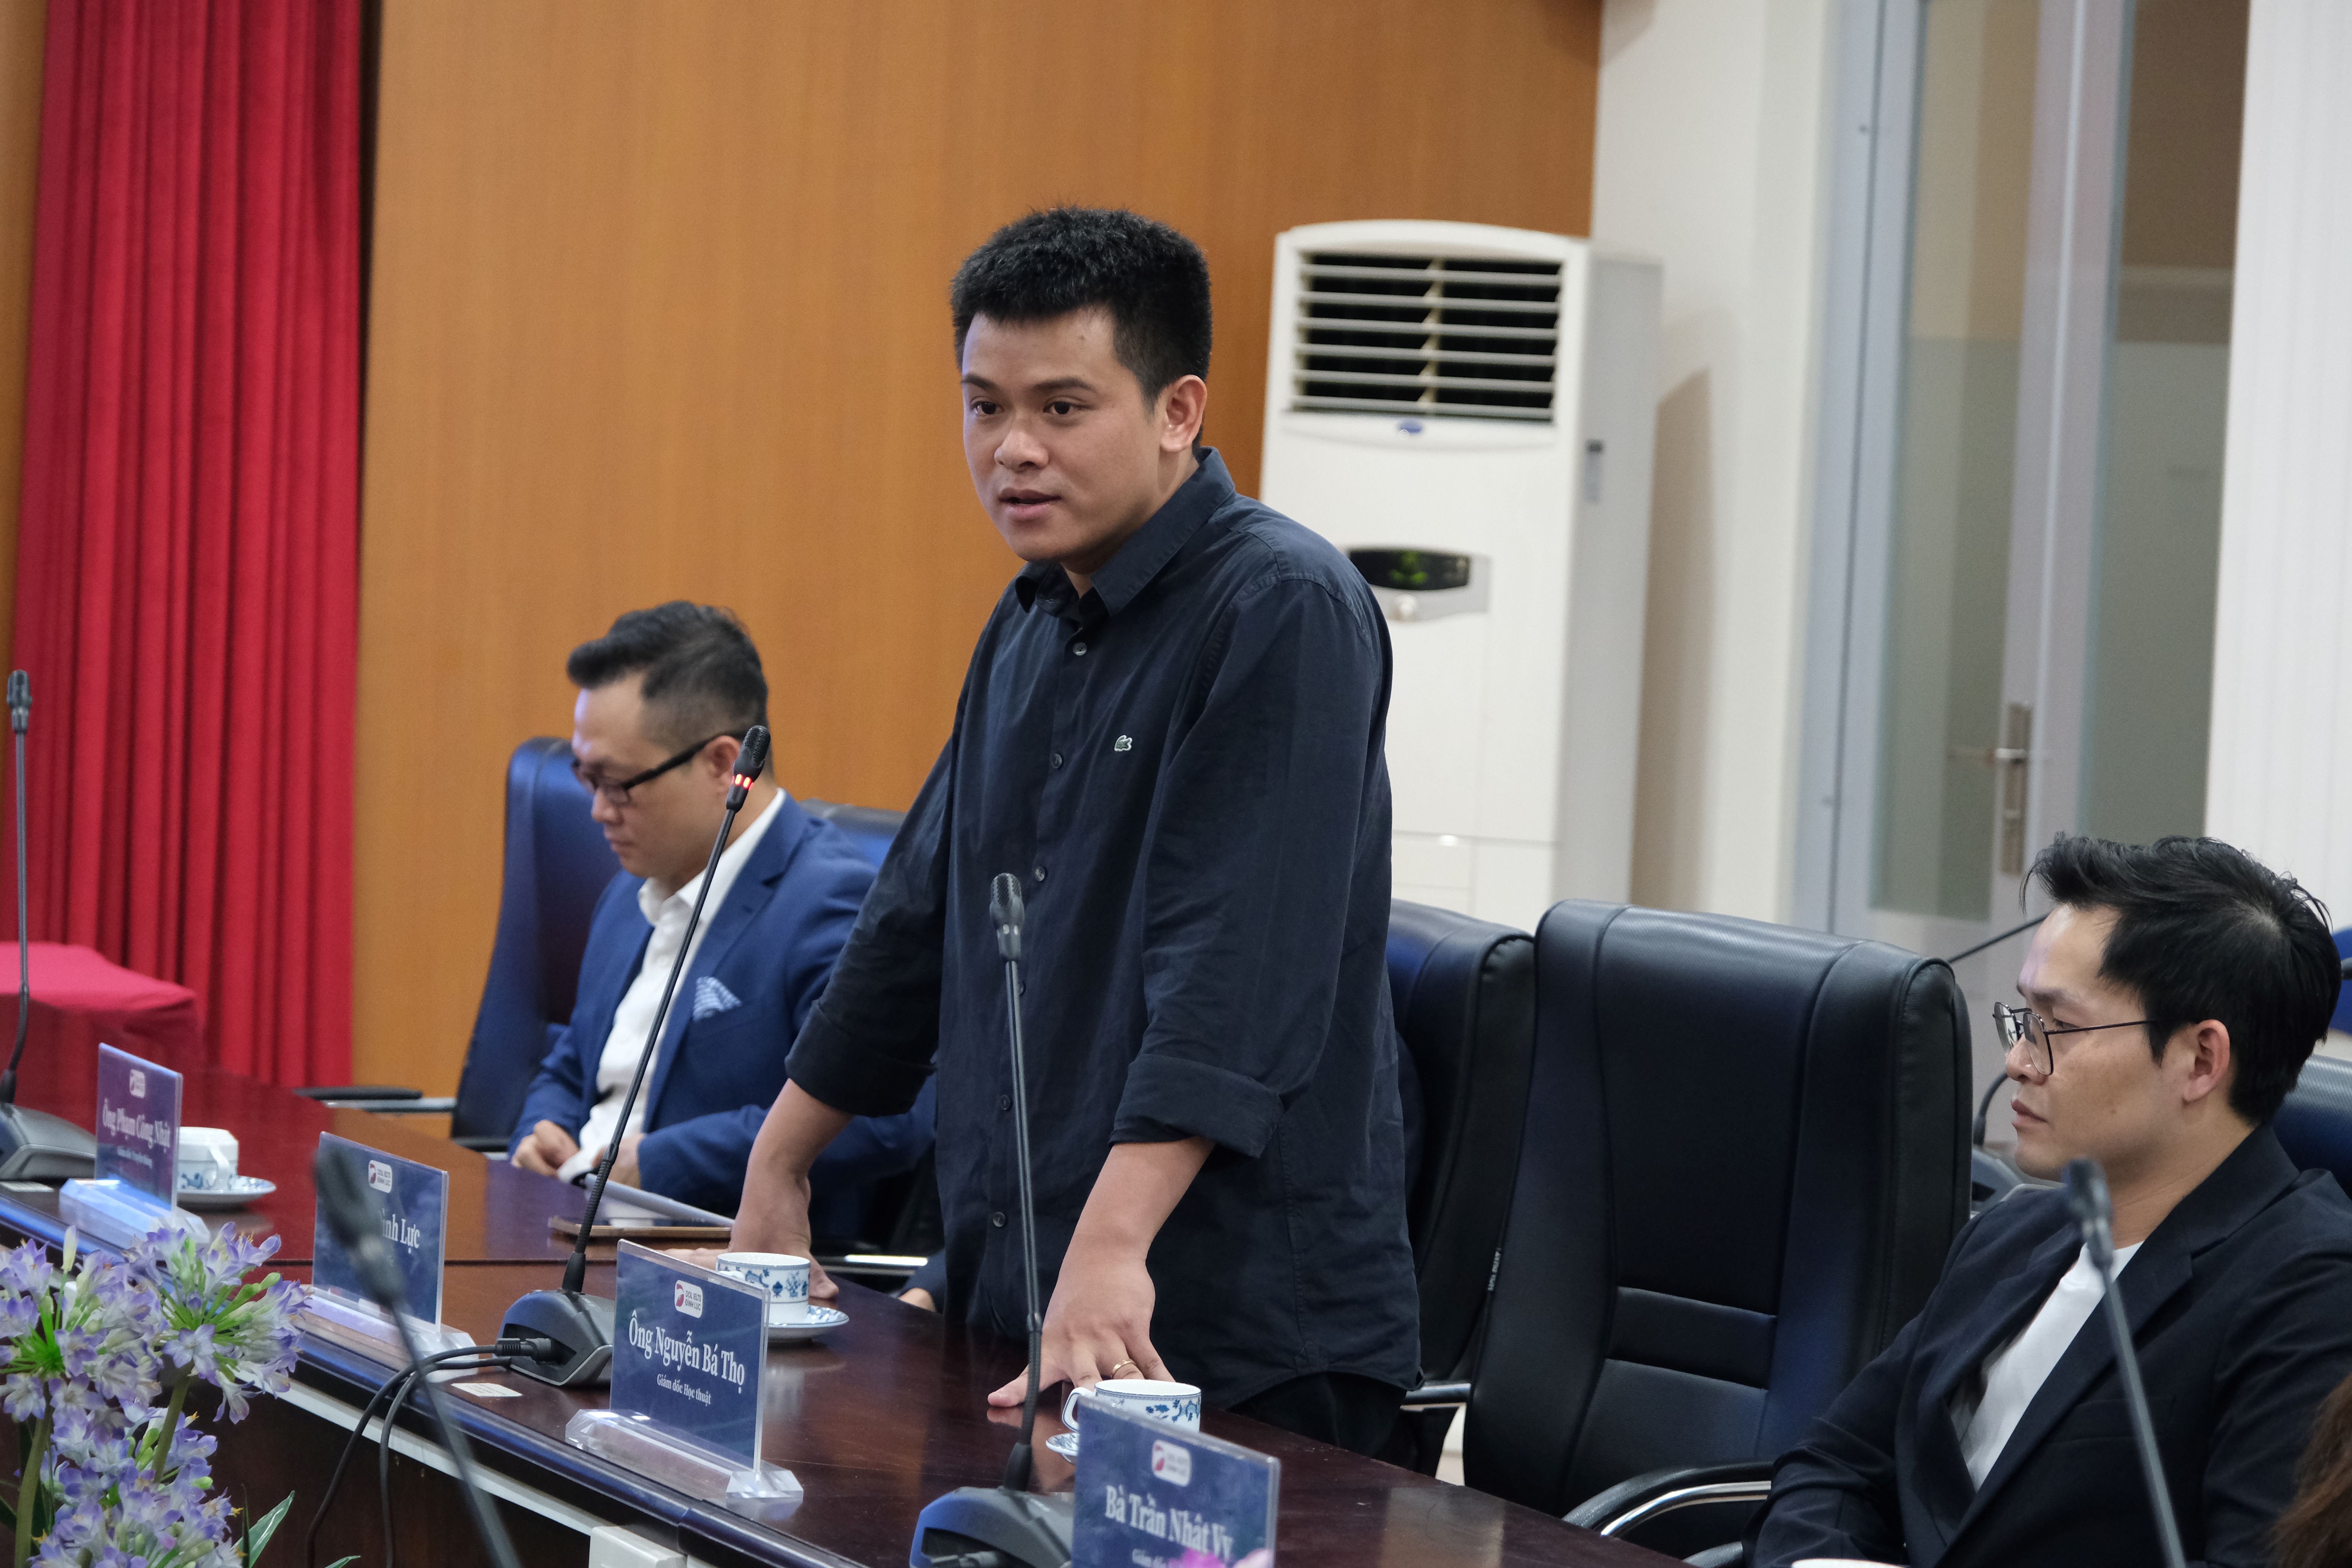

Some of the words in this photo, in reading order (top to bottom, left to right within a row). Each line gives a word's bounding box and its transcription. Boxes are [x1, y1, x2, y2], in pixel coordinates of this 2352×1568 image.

[379, 1208, 398, 1242] ình
[400, 1218, 420, 1254] Lực
[693, 1293, 701, 1302] IELTS
[629, 1309, 653, 1359] Ông
[654, 1330, 700, 1372] Nguyễn
[702, 1343, 718, 1377] Bá
[721, 1350, 745, 1394] Thọ
[657, 1374, 672, 1390] Giám
[683, 1383, 695, 1400] Học
[695, 1388, 711, 1407] thuật
[1105, 1484, 1126, 1524] Bà
[1129, 1493, 1167, 1539] Trần
